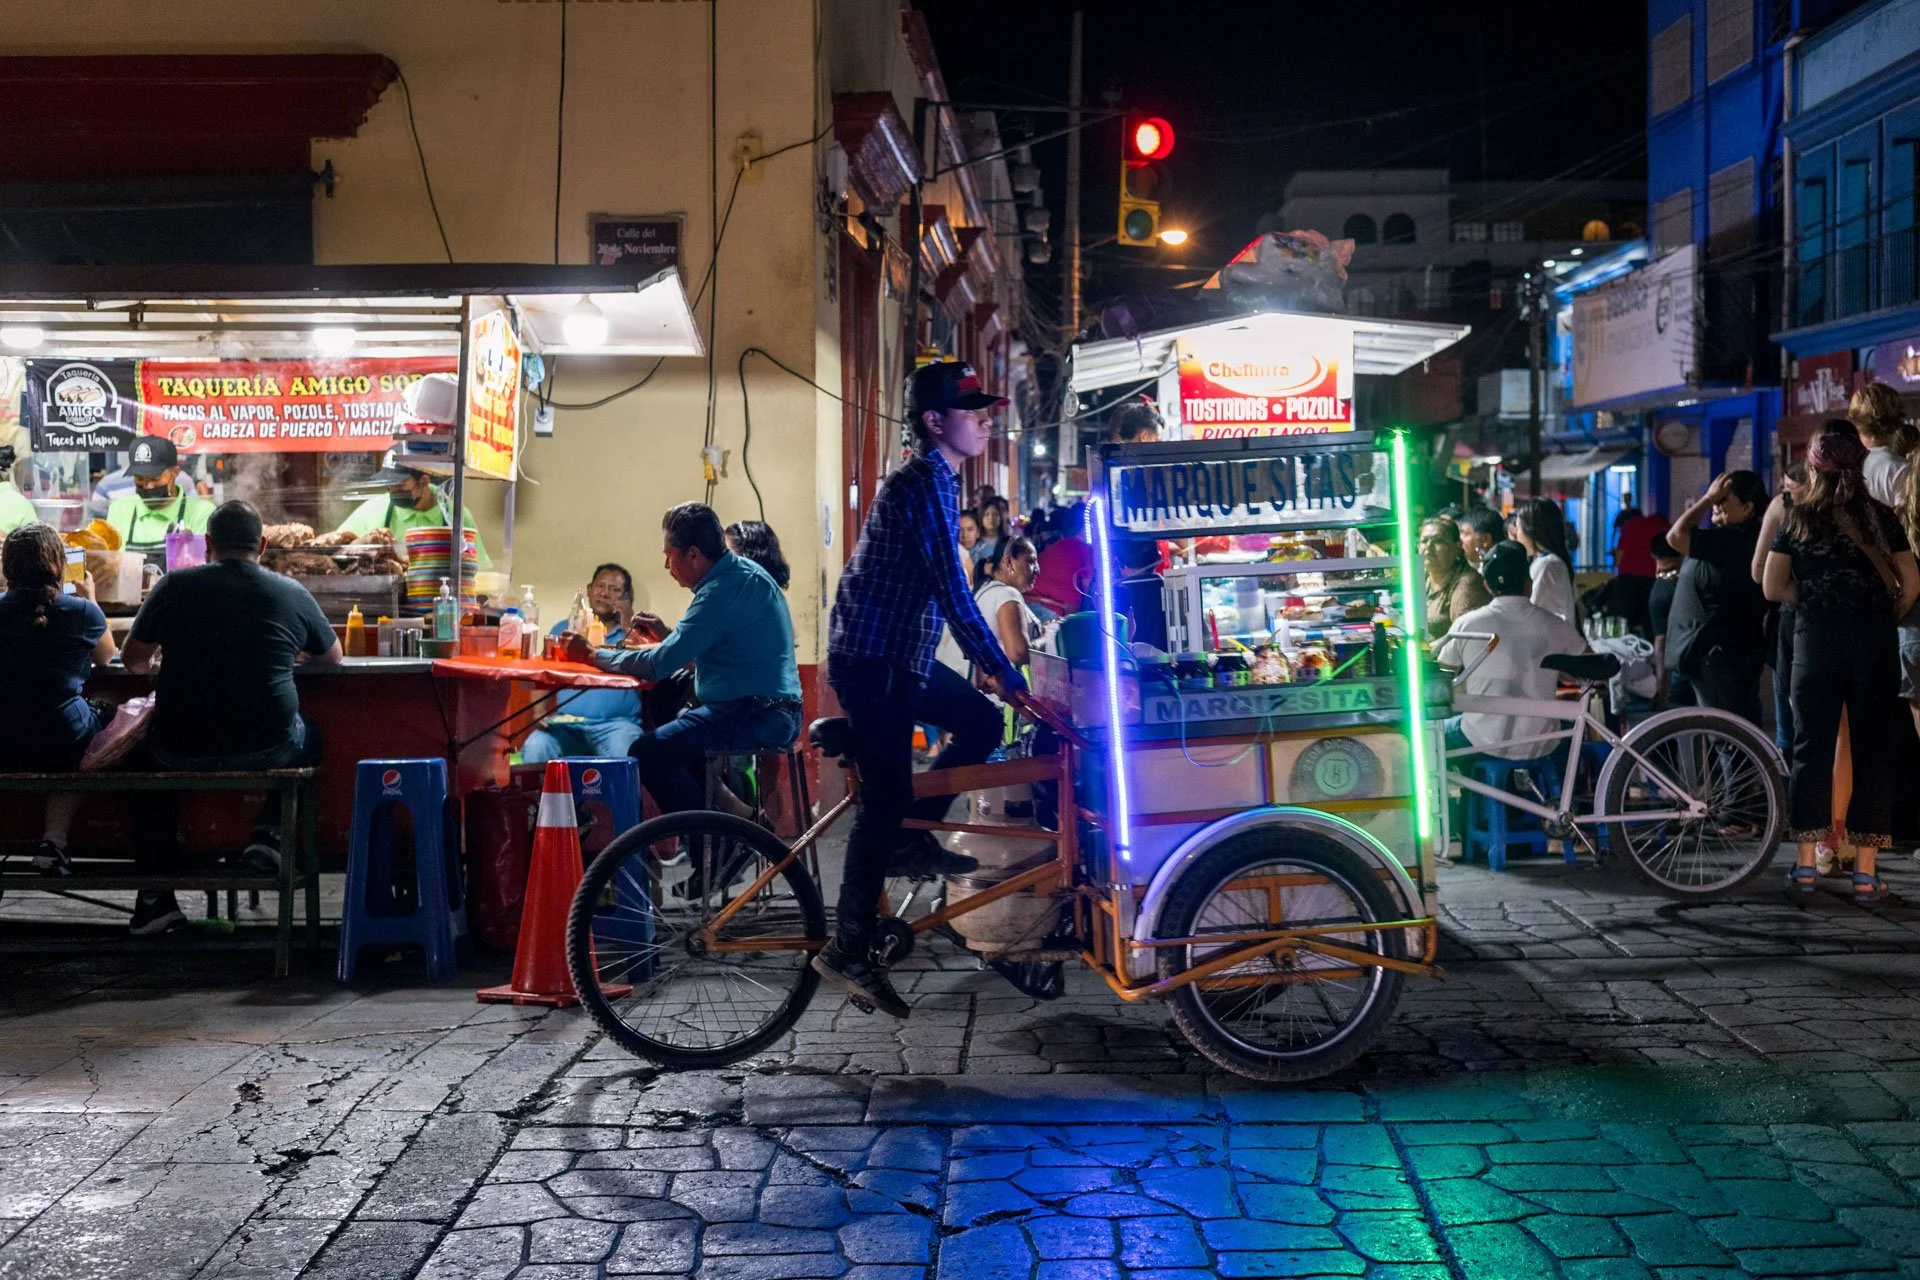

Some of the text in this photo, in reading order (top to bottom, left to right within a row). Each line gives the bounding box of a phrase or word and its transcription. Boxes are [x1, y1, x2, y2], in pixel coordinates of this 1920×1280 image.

[616, 227, 656, 239] Calle del
[624, 243, 677, 255] Noviembre
[157, 373, 283, 400] TAQUERÍA
[289, 375, 372, 396] AMIGO
[58, 405, 105, 418] AMIGO
[162, 404, 206, 421] TACOS
[209, 404, 228, 421] AL
[229, 404, 281, 422] VAPOR,
[282, 403, 339, 422] POZOLE,
[1184, 395, 1346, 422] TOSTADAS POZOLE
[203, 419, 397, 438] CABEZA DE PUERCO Y MACIZ
[45, 432, 119, 448] Tacos al Vapor
[1120, 451, 1357, 524] MARQUESITAS
